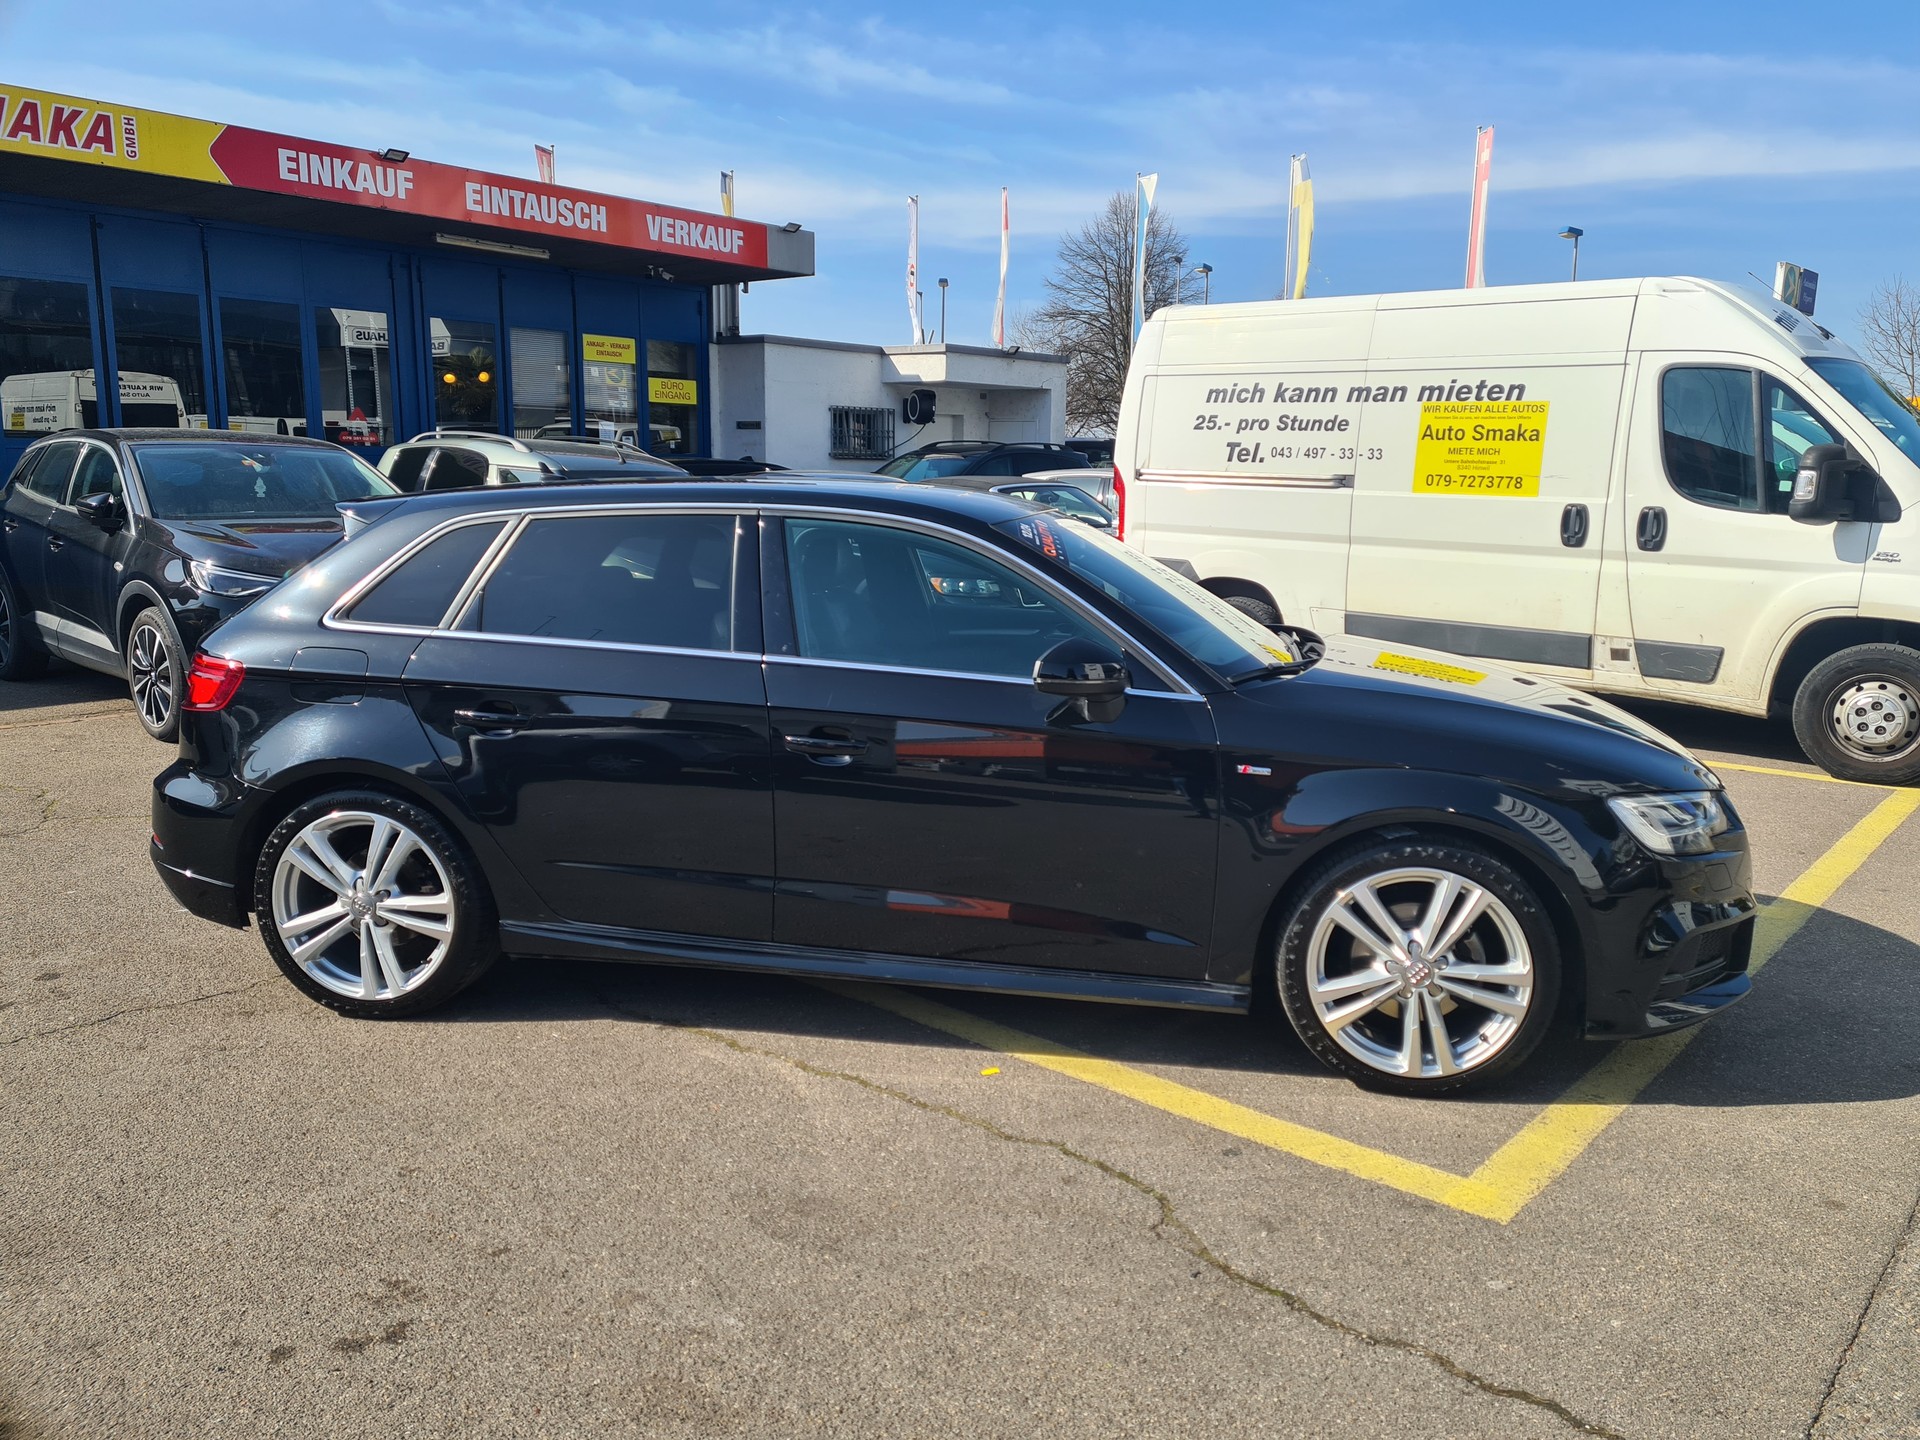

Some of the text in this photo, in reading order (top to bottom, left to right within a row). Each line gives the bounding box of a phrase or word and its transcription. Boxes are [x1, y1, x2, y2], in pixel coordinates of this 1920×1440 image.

[122, 115, 139, 160] GMBH
[277, 148, 414, 200] EINKAUF
[465, 181, 607, 233] EINTAUSCH
[646, 213, 744, 254] VERKAUF
[586, 340, 606, 348] ANKAUF
[610, 341, 631, 350] VERKAUF
[654, 390, 691, 400] EINGANG
[661, 380, 684, 391] BÜRO
[1205, 379, 1526, 403] mich kann man mieten
[1423, 404, 1546, 413] WIR KAUFEN ALLE AUTOS
[1193, 414, 1350, 434] 25.- pro Stunde
[1421, 423, 1540, 442] Auto Smaka
[1225, 442, 1265, 464] Tel.
[1271, 446, 1292, 460] 043
[1304, 446, 1326, 459] 497
[1339, 447, 1354, 460] 33
[1367, 447, 1383, 460] 33
[1448, 448, 1500, 456] MIETE MICH
[1426, 474, 1523, 490] 079-7273778
